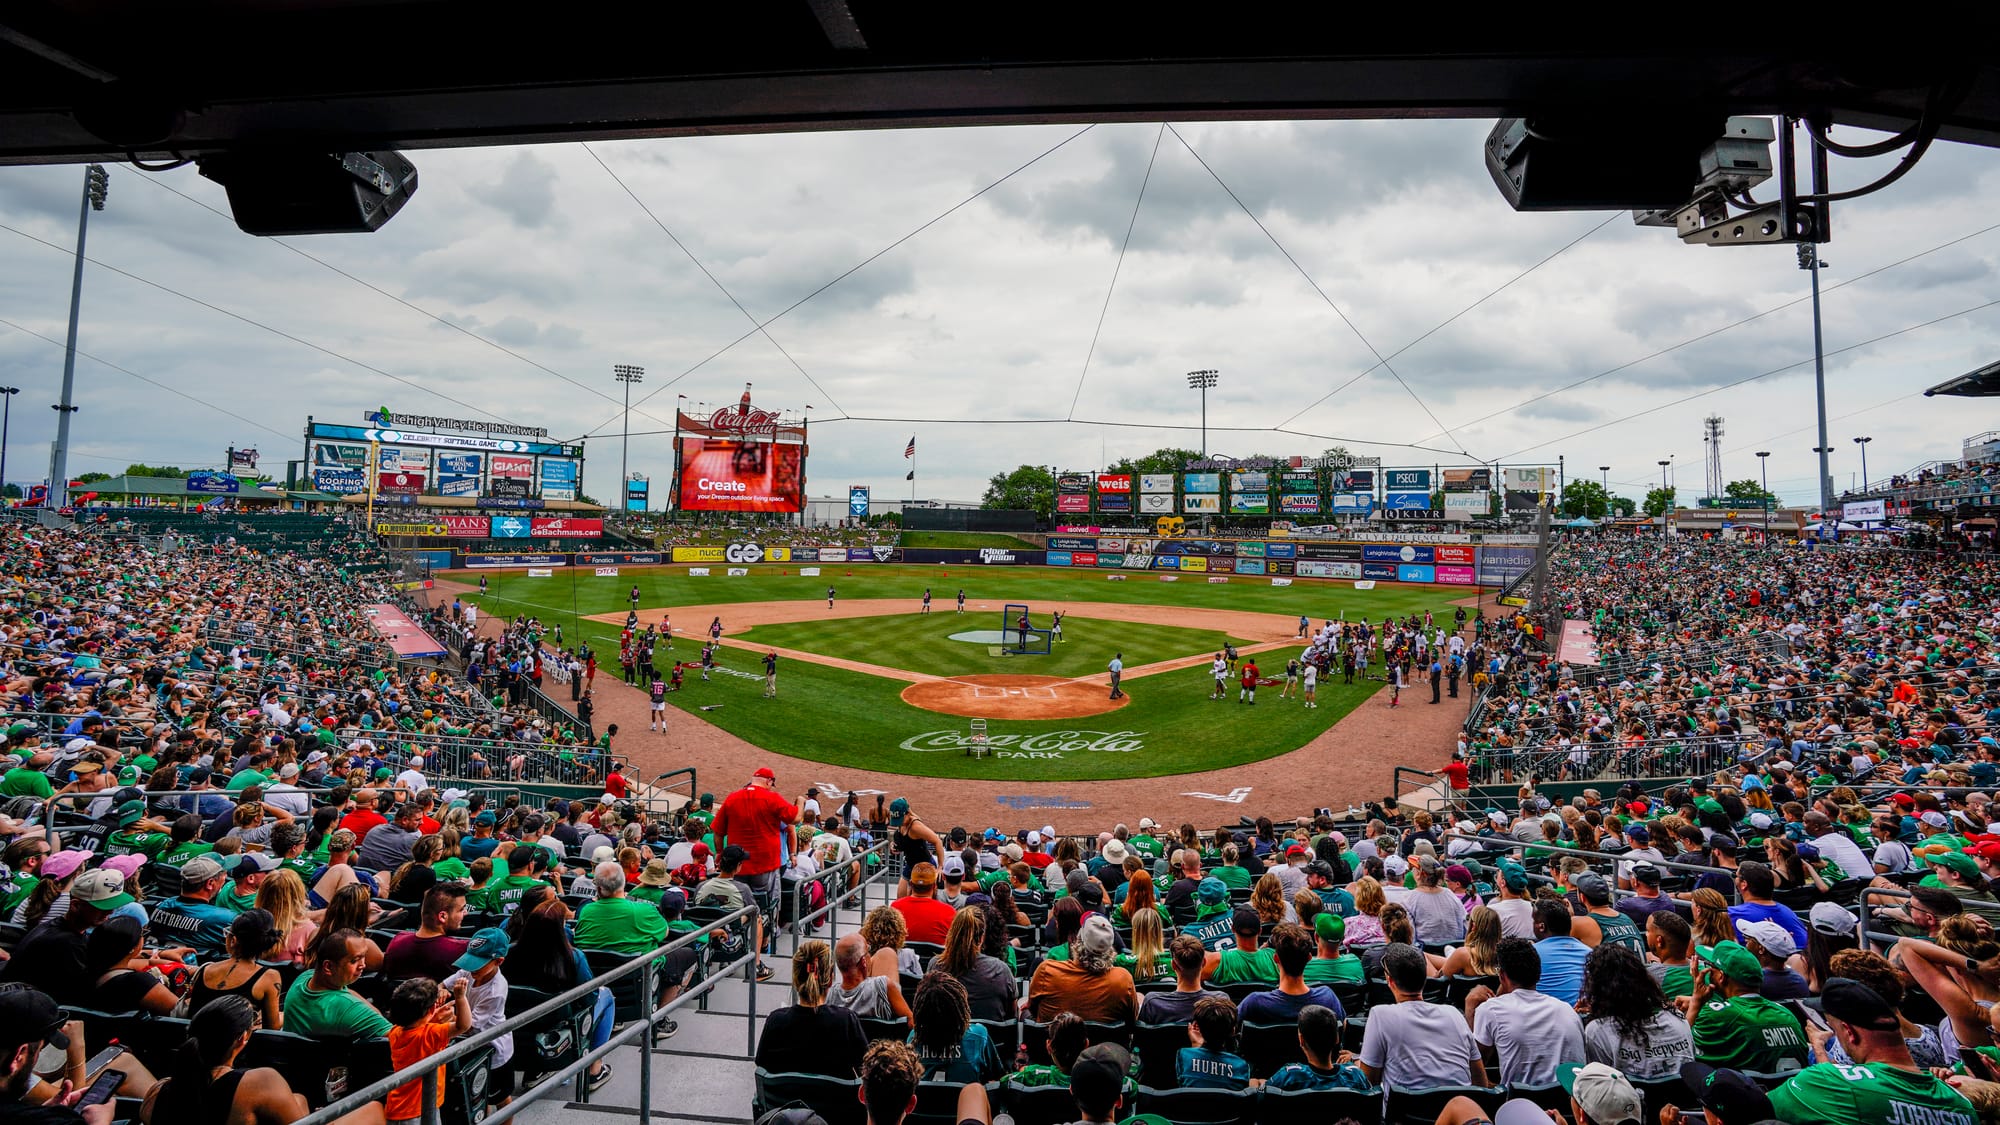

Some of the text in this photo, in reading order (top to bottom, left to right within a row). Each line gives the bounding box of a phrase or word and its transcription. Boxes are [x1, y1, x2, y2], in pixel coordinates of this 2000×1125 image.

[392, 413, 546, 437] Lehigh Valley Health Network
[710, 408, 781, 435] Coca-Cola
[402, 434, 443, 443] CELEBRITY
[444, 438, 477, 447] SOFTBALL
[446, 460, 473, 468] MORNING
[493, 462, 530, 472] GIANT
[319, 477, 361, 486] ROOFING
[1396, 473, 1418, 484] PSECU
[1518, 470, 1538, 482] US
[698, 478, 746, 492] Create
[1098, 478, 1130, 489] weis
[1186, 498, 1217, 508] WM
[1293, 496, 1317, 505] NEWS
[1403, 510, 1440, 518] KLYR
[531, 528, 601, 537] GoBachmans.com
[726, 543, 760, 562] GO
[979, 547, 1009, 559] Clear
[984, 553, 1016, 564] Vision
[1482, 554, 1531, 565] viamedia
[1407, 571, 1418, 579] ppl
[899, 730, 1149, 752] Coca-Cola
[997, 751, 1064, 759] PARK
[1136, 841, 1151, 849] KELCE
[167, 851, 190, 865] KELCE
[500, 888, 522, 900] SMITH
[576, 886, 597, 897] BROWN
[1324, 902, 1343, 913] SMITH
[1198, 918, 1234, 940] SMITH
[1143, 963, 1168, 978] KLCE
[1761, 1026, 1800, 1048] SMITH
[1619, 1041, 1690, 1062] Big Steppers
[1192, 1058, 1233, 1078] HURTS
[1886, 1098, 1973, 1125] JOHNSON
